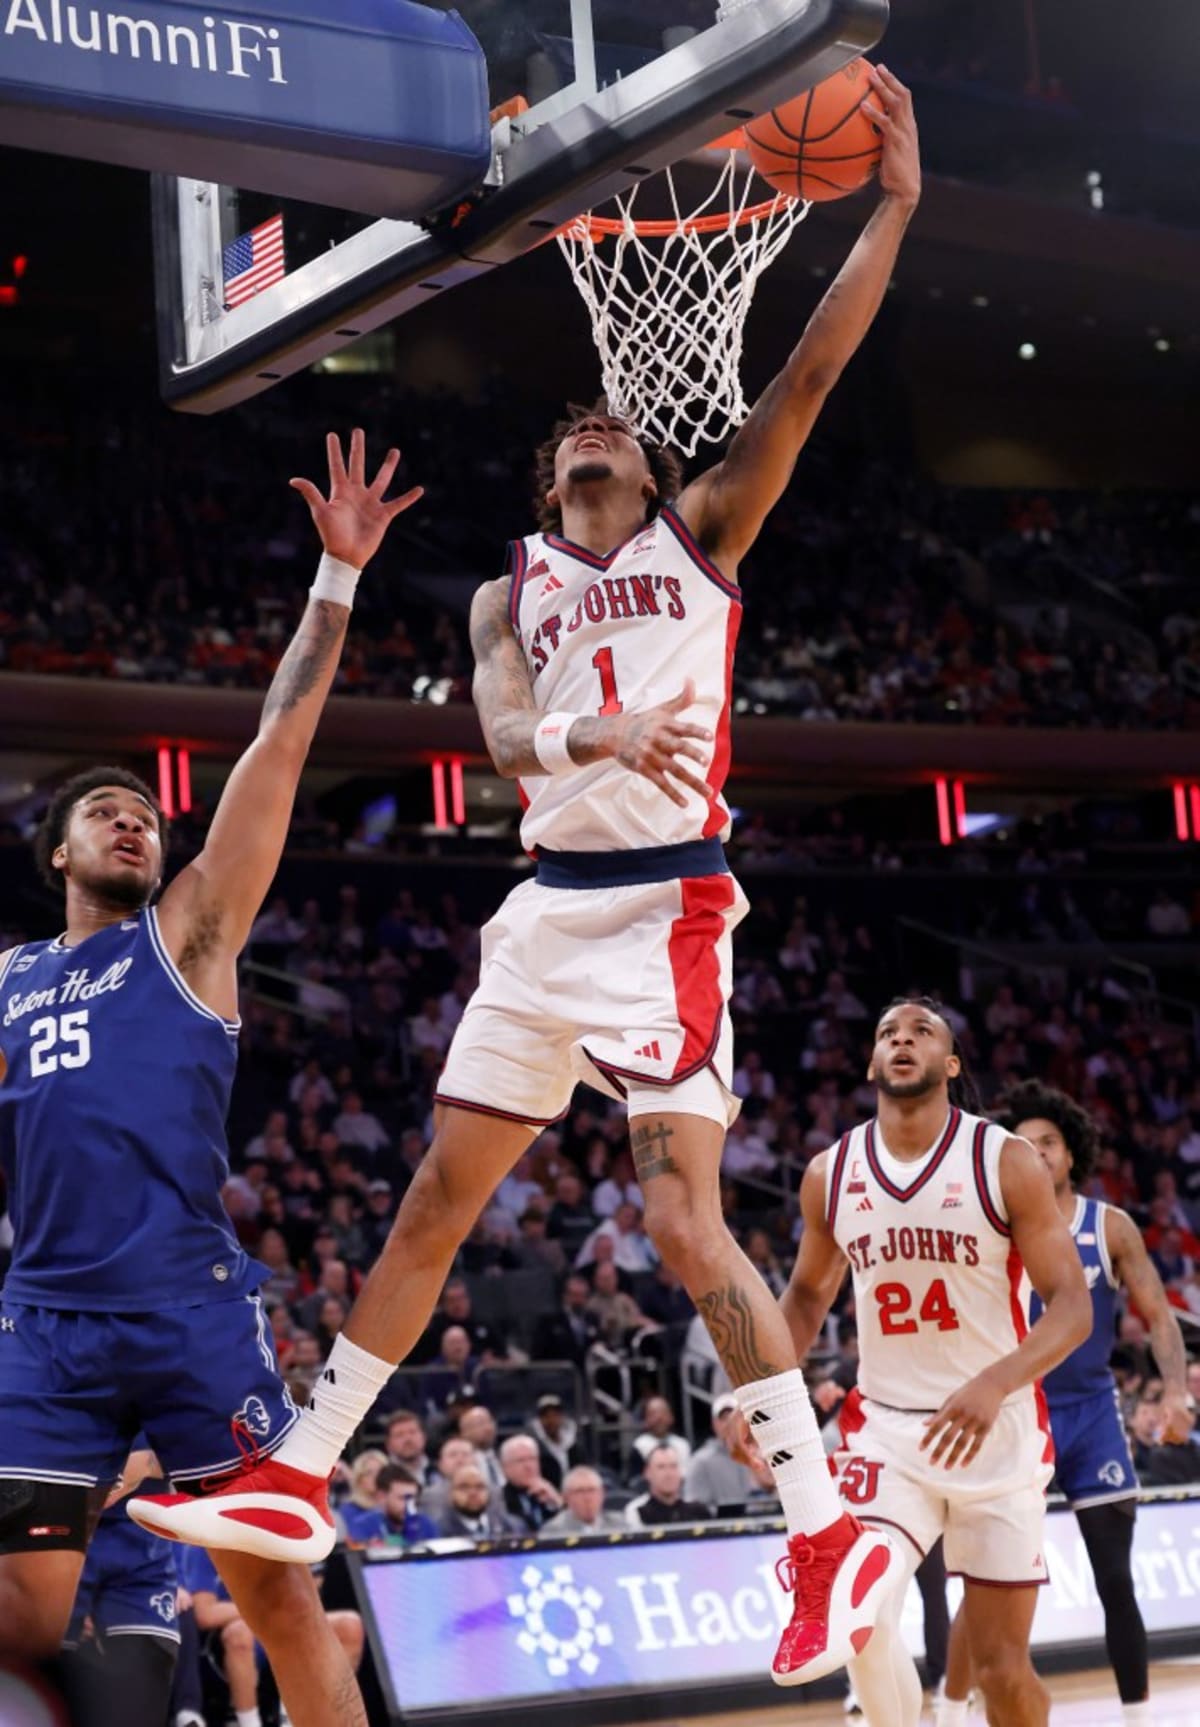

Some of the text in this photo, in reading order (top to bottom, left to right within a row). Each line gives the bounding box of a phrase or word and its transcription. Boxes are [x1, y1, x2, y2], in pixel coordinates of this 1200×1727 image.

[5, 0, 288, 84] AlumniFi
[567, 573, 686, 631] JOHN'S
[592, 646, 624, 717] 1
[3, 987, 57, 1027] Seton
[59, 956, 134, 1004] Hall
[29, 1008, 91, 1079] 25
[847, 1226, 980, 1274] ST. JOHN'S
[874, 1278, 960, 1336] 24
[1043, 1527, 1200, 1610] Mri
